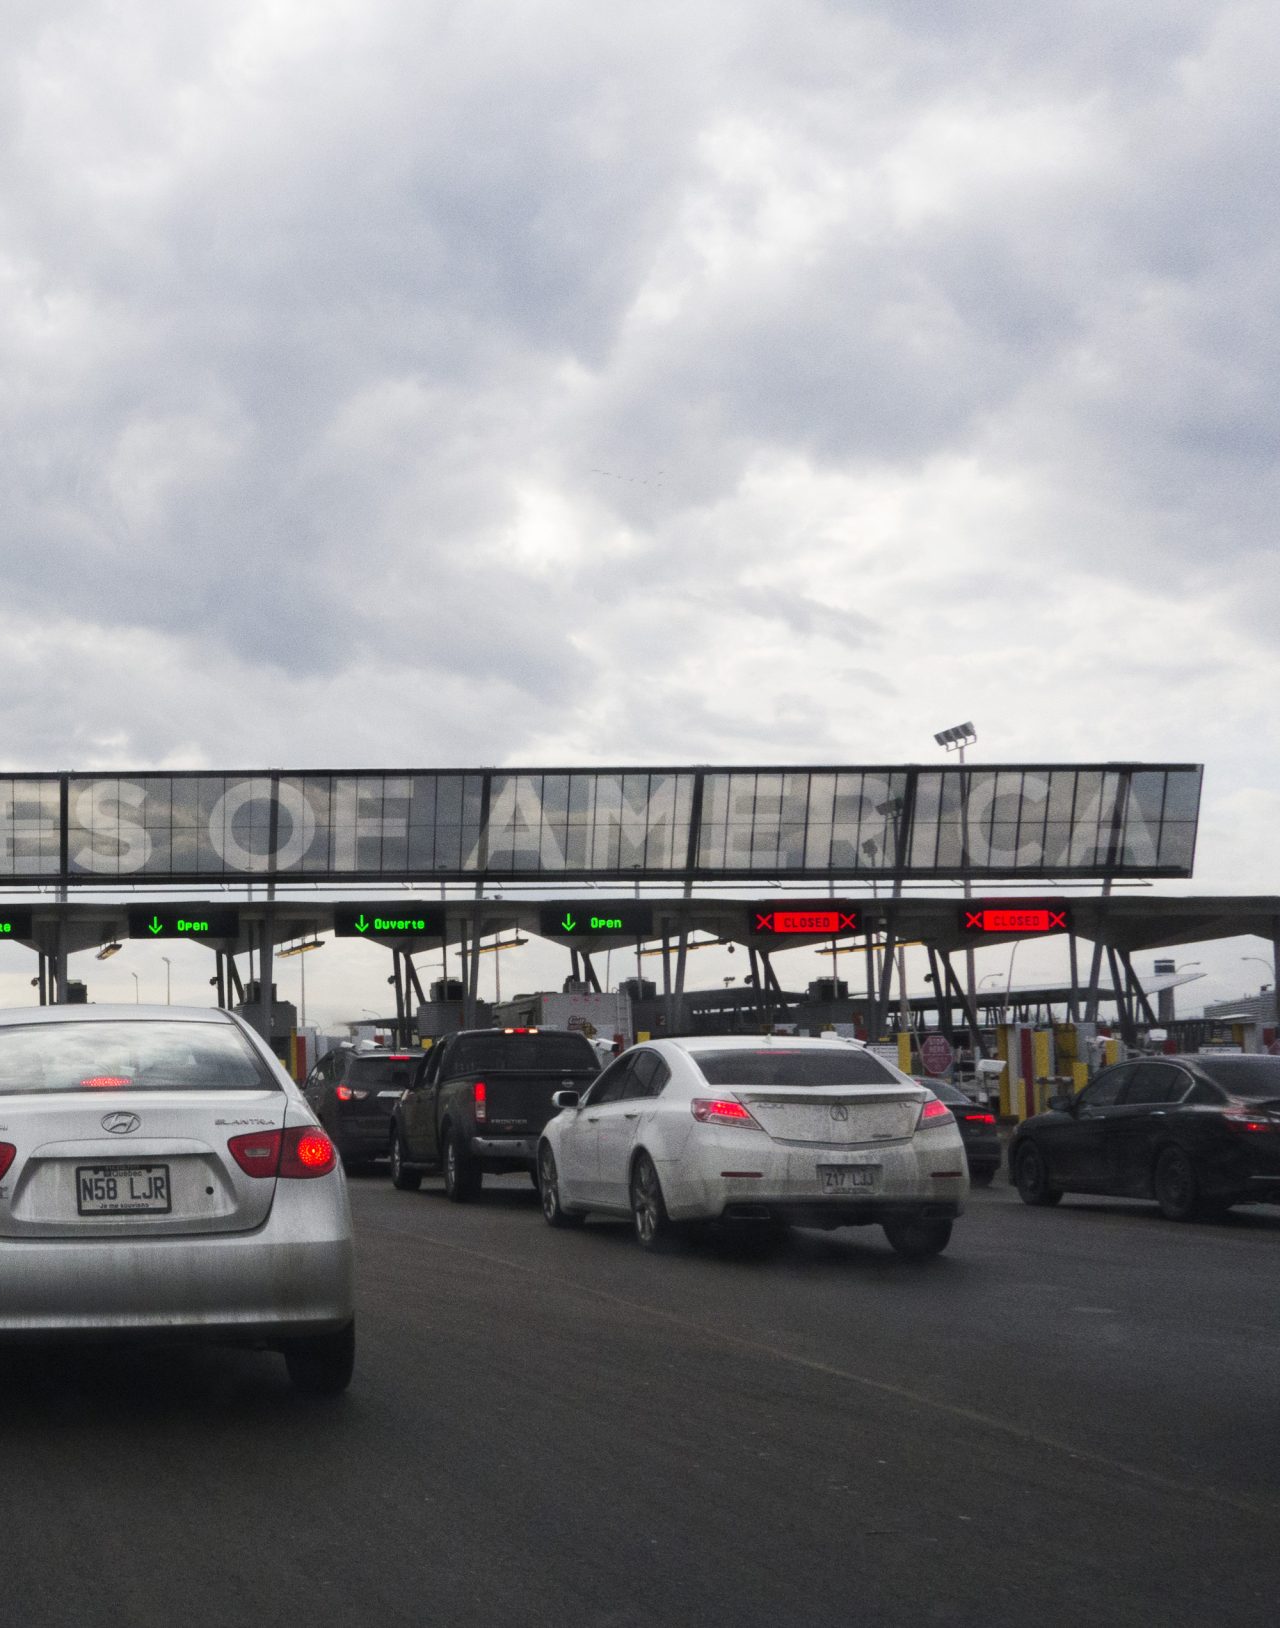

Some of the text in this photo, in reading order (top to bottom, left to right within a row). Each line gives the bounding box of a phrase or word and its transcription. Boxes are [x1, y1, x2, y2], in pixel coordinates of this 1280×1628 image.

[208, 777, 415, 874] OF
[463, 772, 1160, 871] AMERICA
[177, 919, 209, 931] Open
[374, 918, 425, 930] Ouverte
[590, 916, 622, 929] Open
[783, 916, 830, 929] CLOSED
[993, 915, 1040, 927] CLOSED
[81, 1176, 166, 1201] N58 LJR
